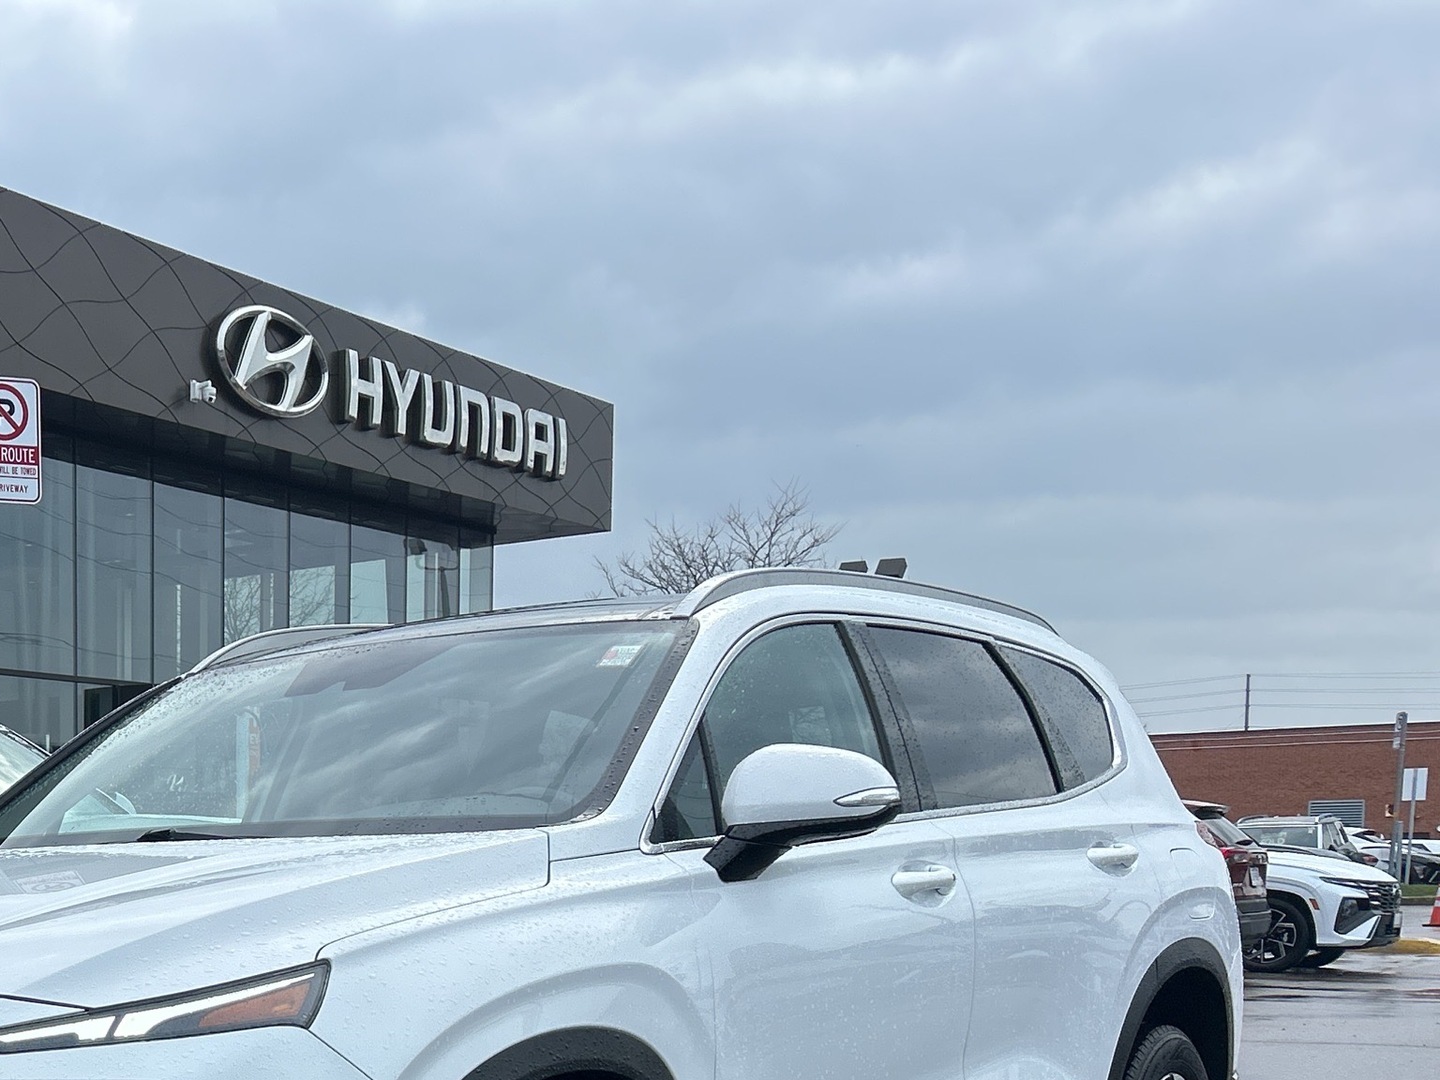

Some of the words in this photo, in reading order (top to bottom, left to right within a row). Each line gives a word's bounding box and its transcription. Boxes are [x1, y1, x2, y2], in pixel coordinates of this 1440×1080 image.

[345, 348, 568, 480] HYUNDAI
[1, 447, 36, 463] ROUTE
[12, 466, 18, 475] BE
[20, 467, 36, 476] TOWED
